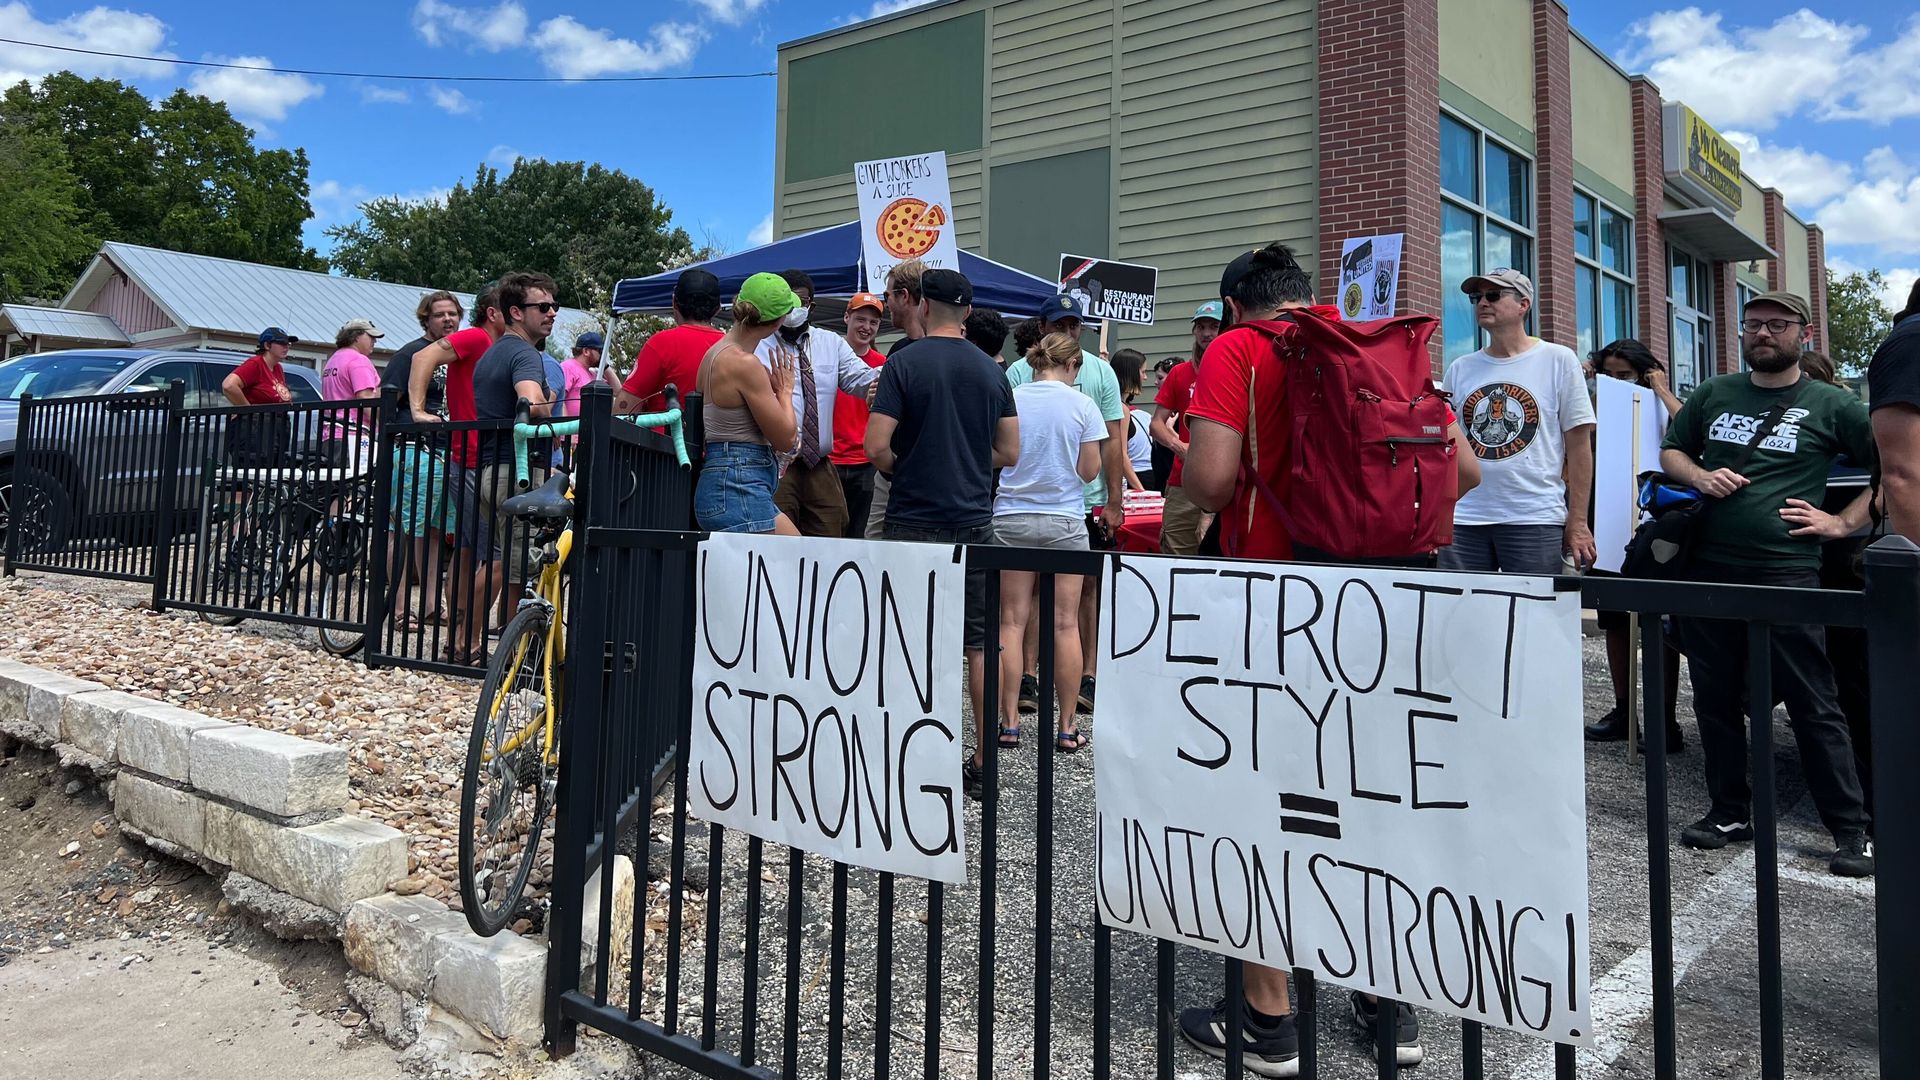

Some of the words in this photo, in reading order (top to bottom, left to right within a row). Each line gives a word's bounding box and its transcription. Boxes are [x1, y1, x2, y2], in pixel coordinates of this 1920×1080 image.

[858, 163, 883, 185] GIVE
[884, 156, 931, 182] WORKERS
[873, 186, 882, 199] A
[886, 182, 913, 198] SLICE
[1104, 288, 1154, 302] RESTAURANT
[1104, 294, 1152, 309] WORKERS
[1094, 301, 1152, 322] UNITED
[1464, 389, 1485, 424] UNION
[1503, 383, 1538, 424] DRIVERS
[1496, 437, 1526, 458] 1549
[1764, 438, 1791, 449] 1624
[702, 549, 936, 714] UNION
[1111, 562, 1557, 719] DETROIT
[1177, 676, 1469, 809] STYLE
[700, 680, 959, 857] STRONG
[1099, 810, 1295, 966] UNION
[1307, 853, 1583, 1037] STRONG!
